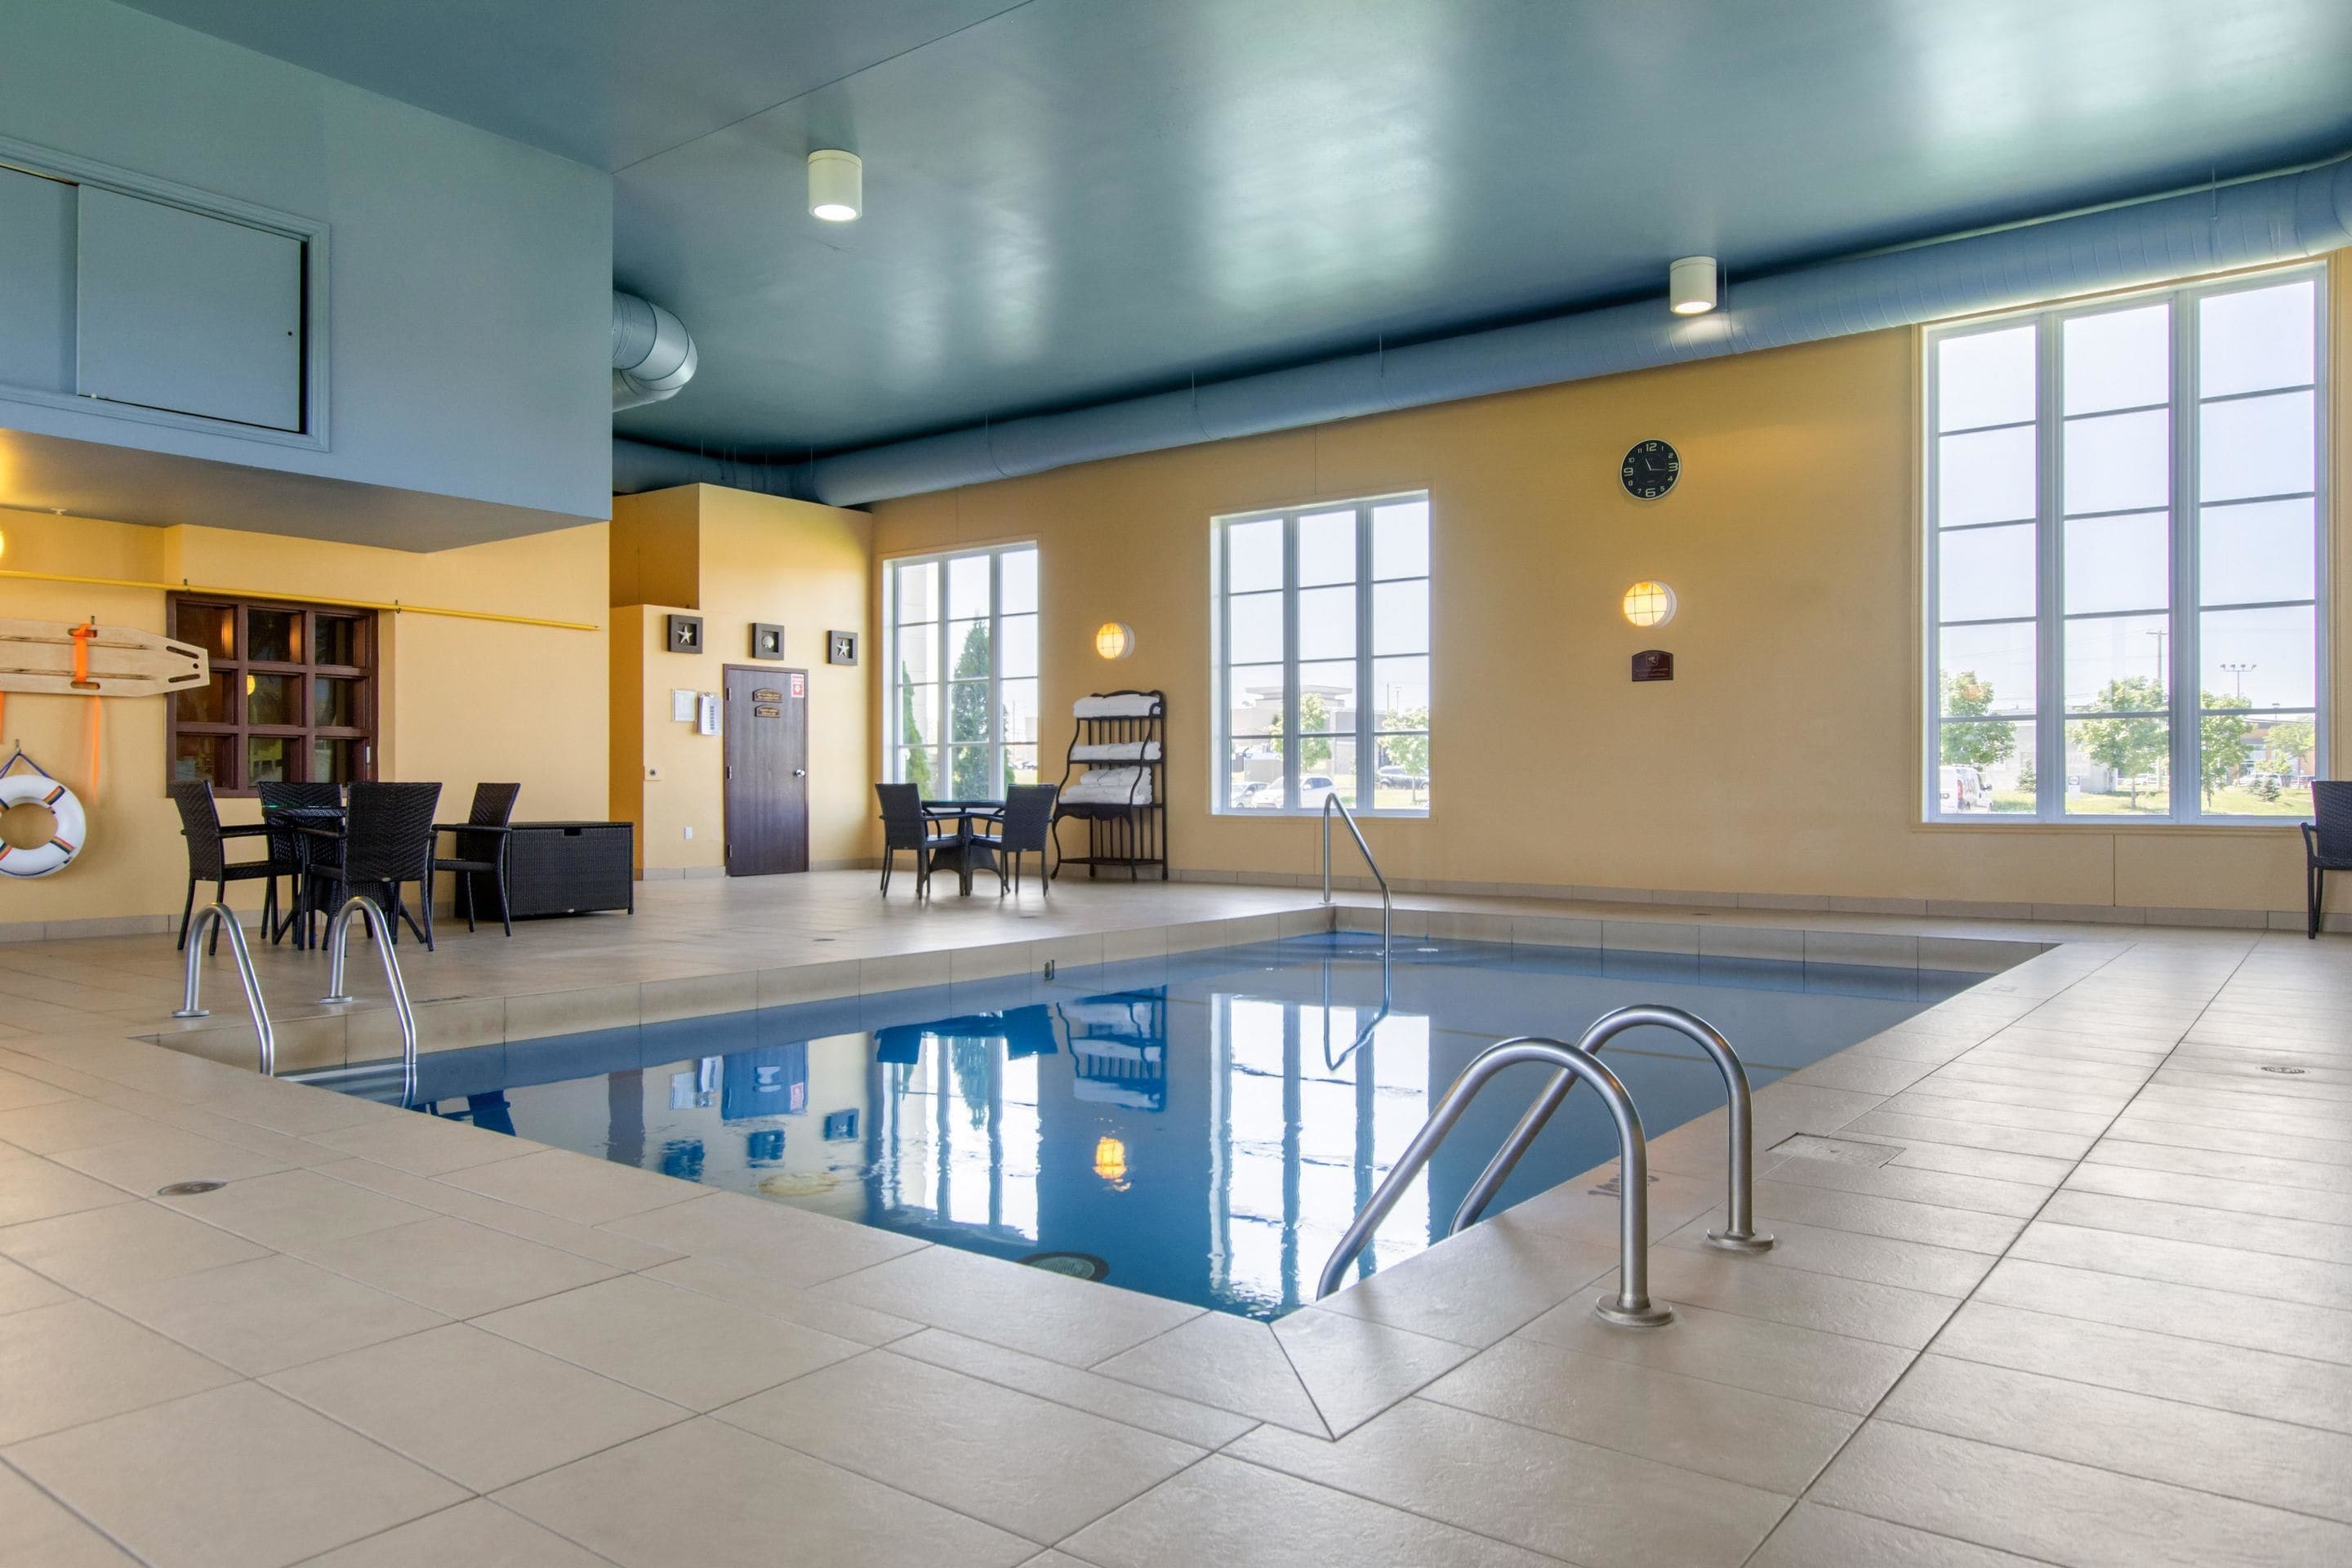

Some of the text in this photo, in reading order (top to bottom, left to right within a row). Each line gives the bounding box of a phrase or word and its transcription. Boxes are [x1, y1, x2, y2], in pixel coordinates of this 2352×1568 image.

[1646, 443, 1657, 452] 12
[1668, 462, 1678, 472] 3
[1624, 467, 1633, 477] 9
[1645, 488, 1656, 497] 6
